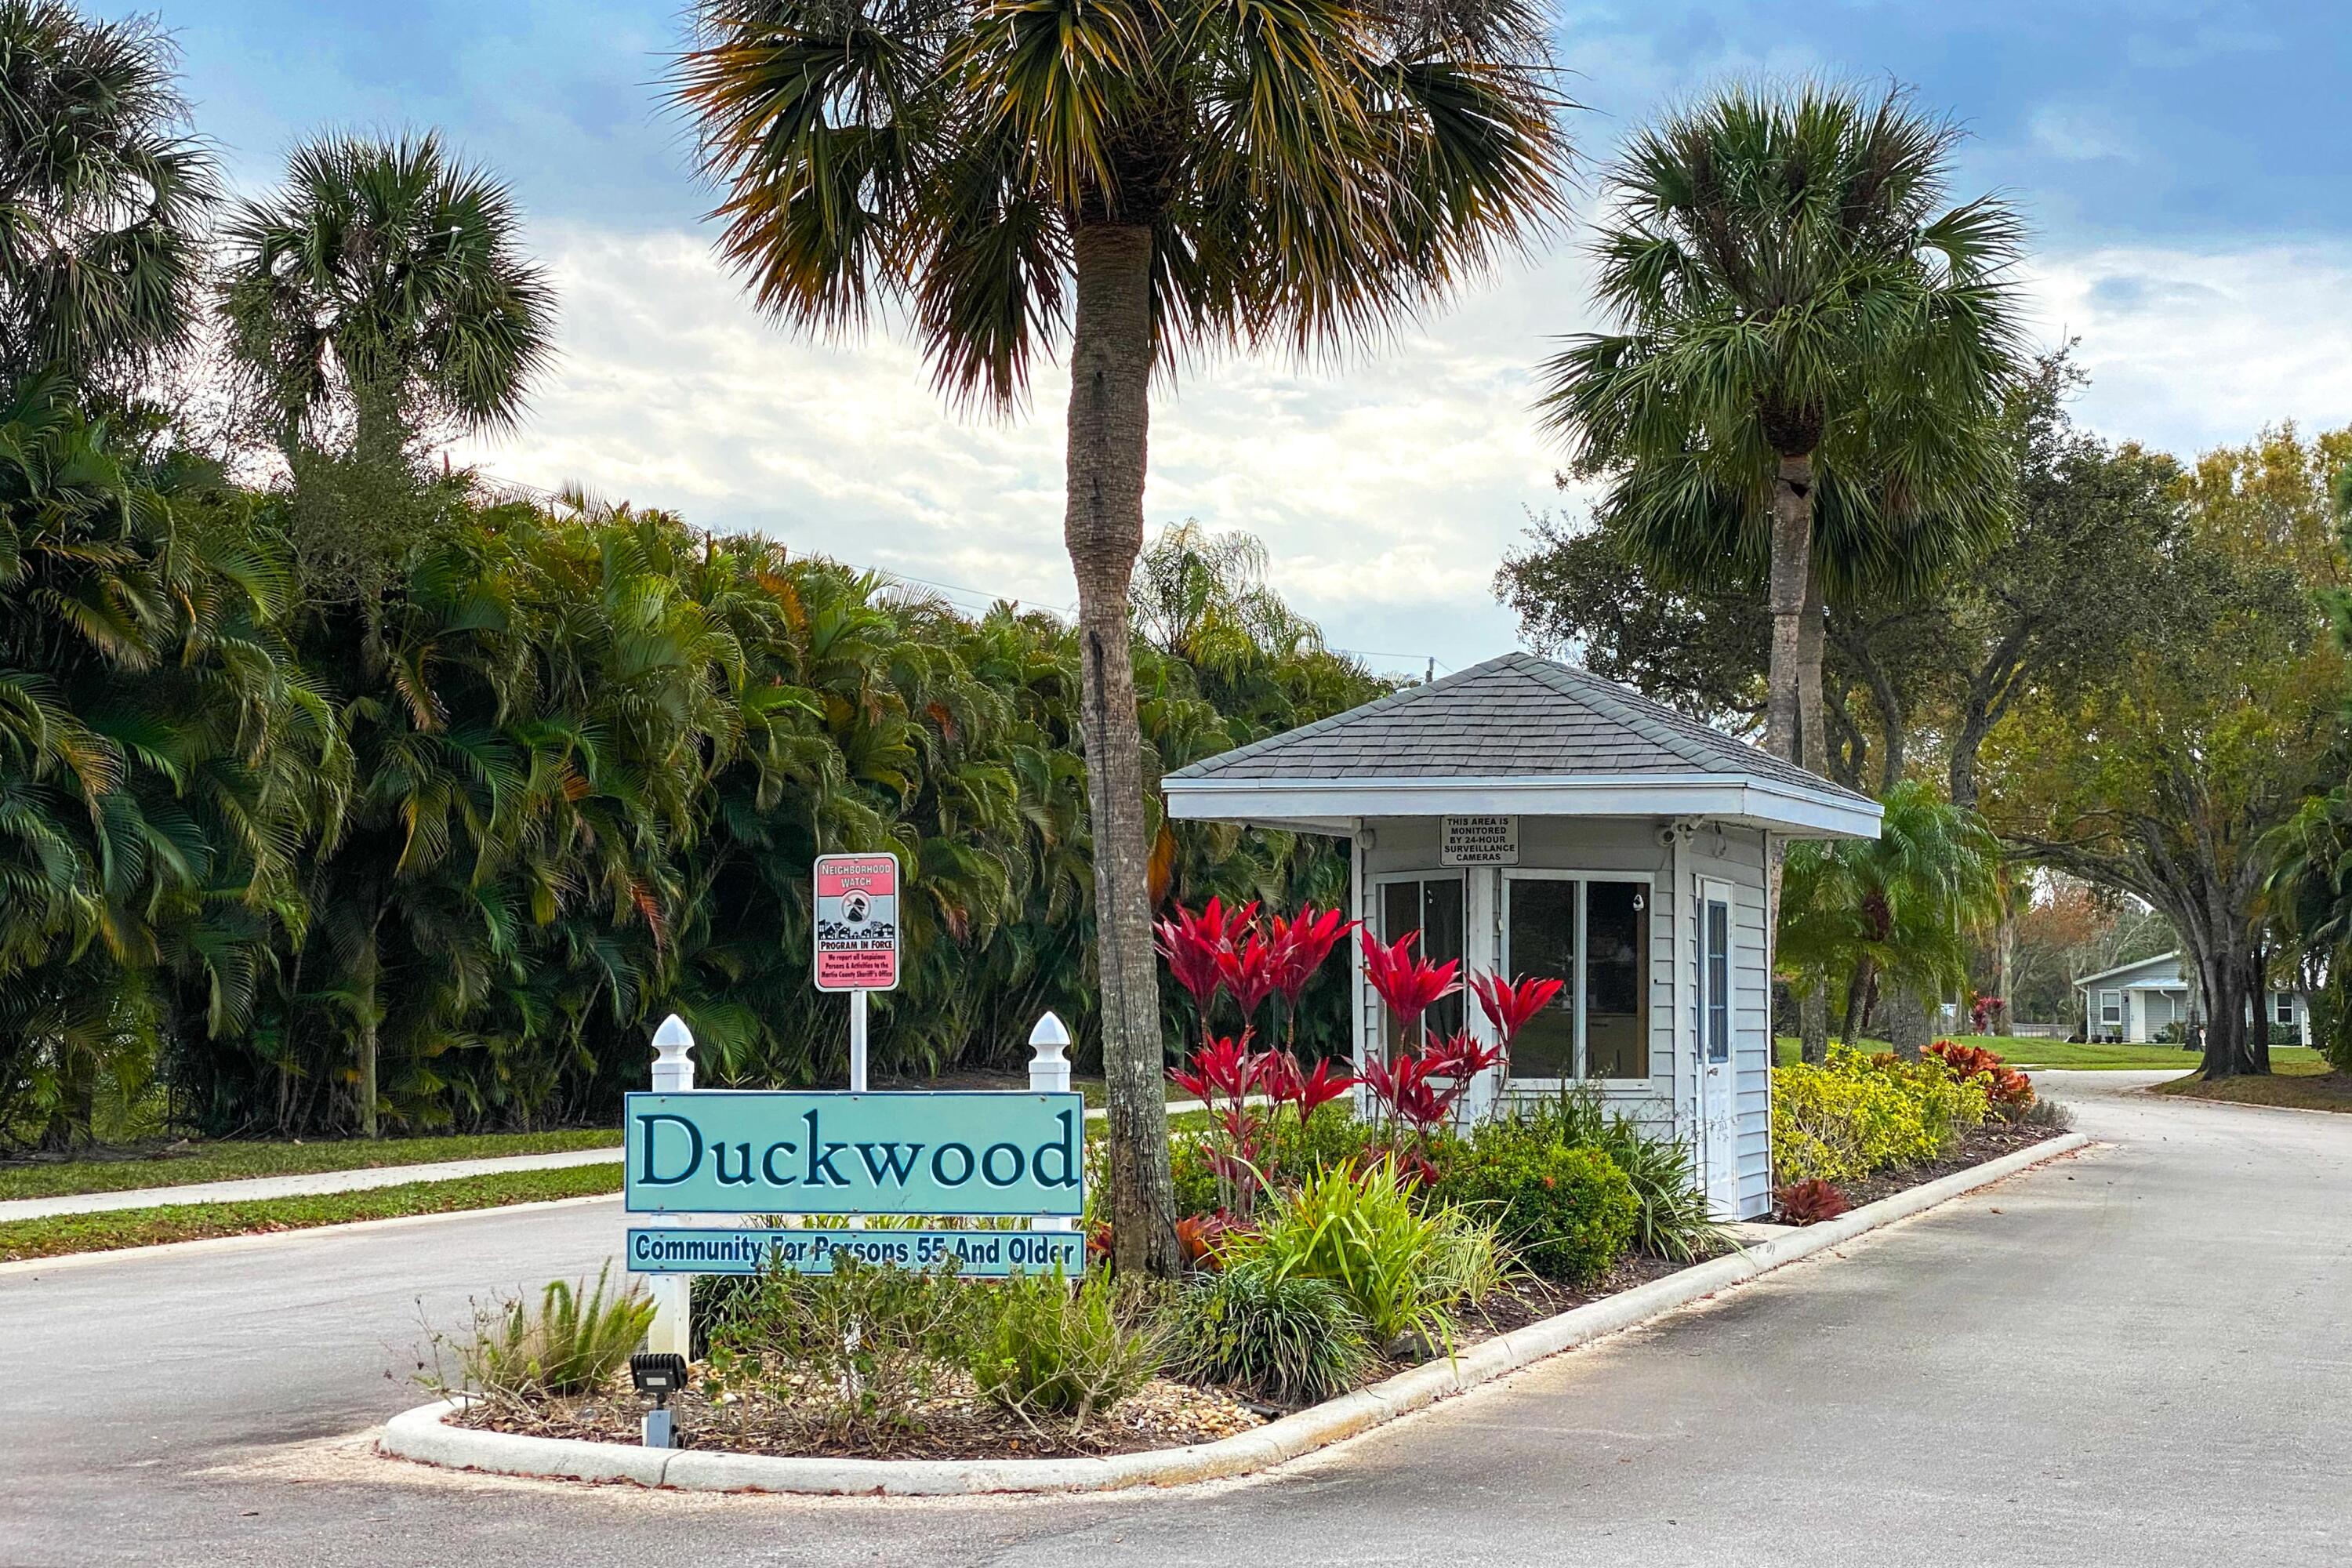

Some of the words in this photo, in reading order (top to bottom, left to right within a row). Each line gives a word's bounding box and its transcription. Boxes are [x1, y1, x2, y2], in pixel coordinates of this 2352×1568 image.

[1451, 826, 1507, 835] MONITORED
[1444, 844, 1515, 853] SURVEILLANCE
[1456, 853, 1501, 862] CAMERAS
[822, 865, 891, 875] NEIGHBORHOOD
[841, 877, 872, 887] WATCH
[821, 942, 858, 950] PROGRAM
[872, 940, 892, 949] FORCE
[635, 1109, 1079, 1190] Duckwood
[636, 1234, 764, 1267] Community
[916, 1236, 946, 1264] 55
[954, 1237, 1000, 1265] And
[1007, 1236, 1075, 1265] Older
